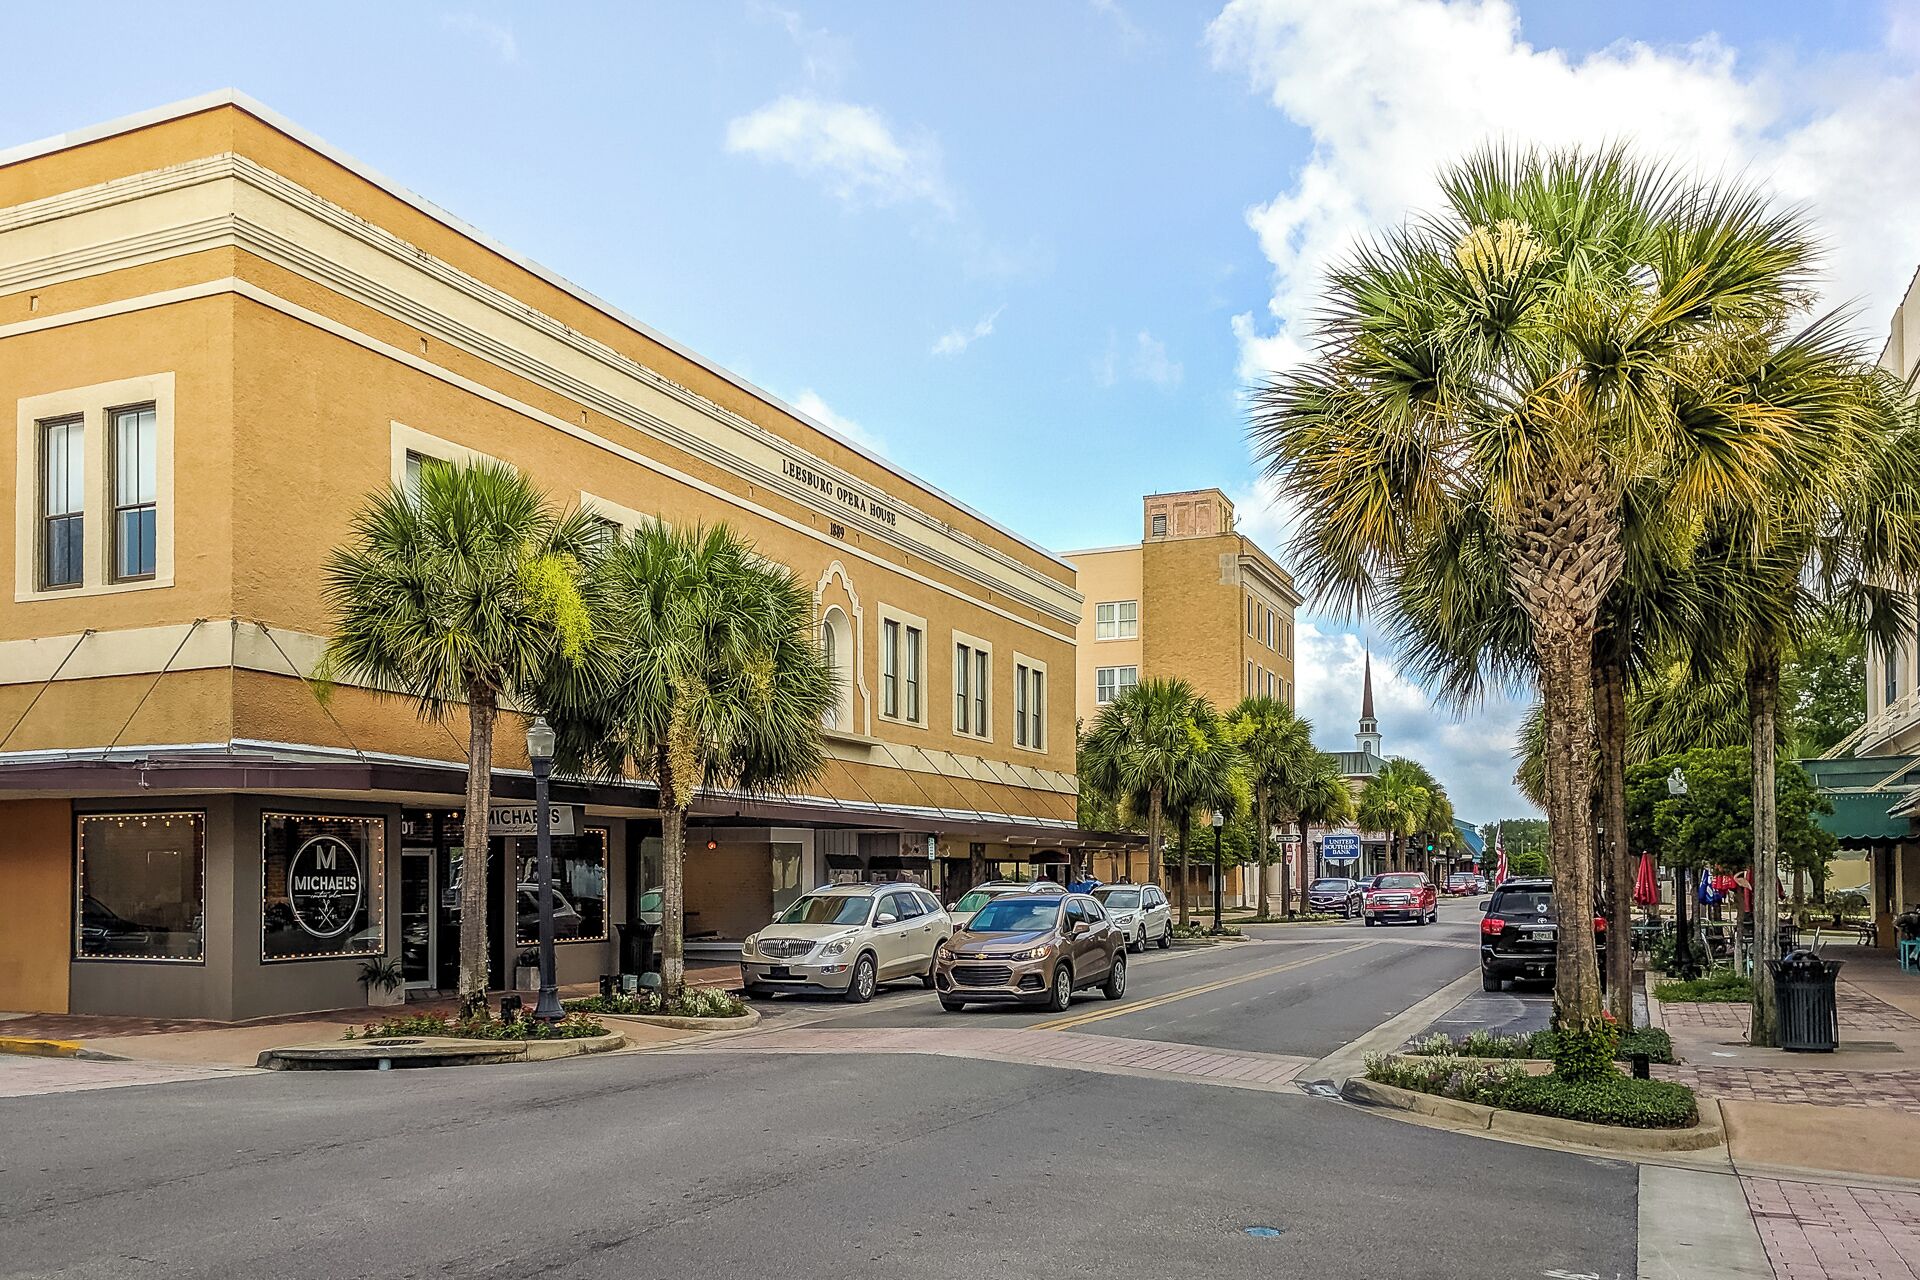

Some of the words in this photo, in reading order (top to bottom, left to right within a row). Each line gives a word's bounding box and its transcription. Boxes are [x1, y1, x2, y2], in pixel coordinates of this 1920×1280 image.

[782, 459, 833, 496] LEESBURG
[837, 487, 866, 513] OPERA
[870, 502, 896, 527] HOUSE
[316, 845, 336, 870] M
[294, 875, 357, 891] MICHAEL'S
